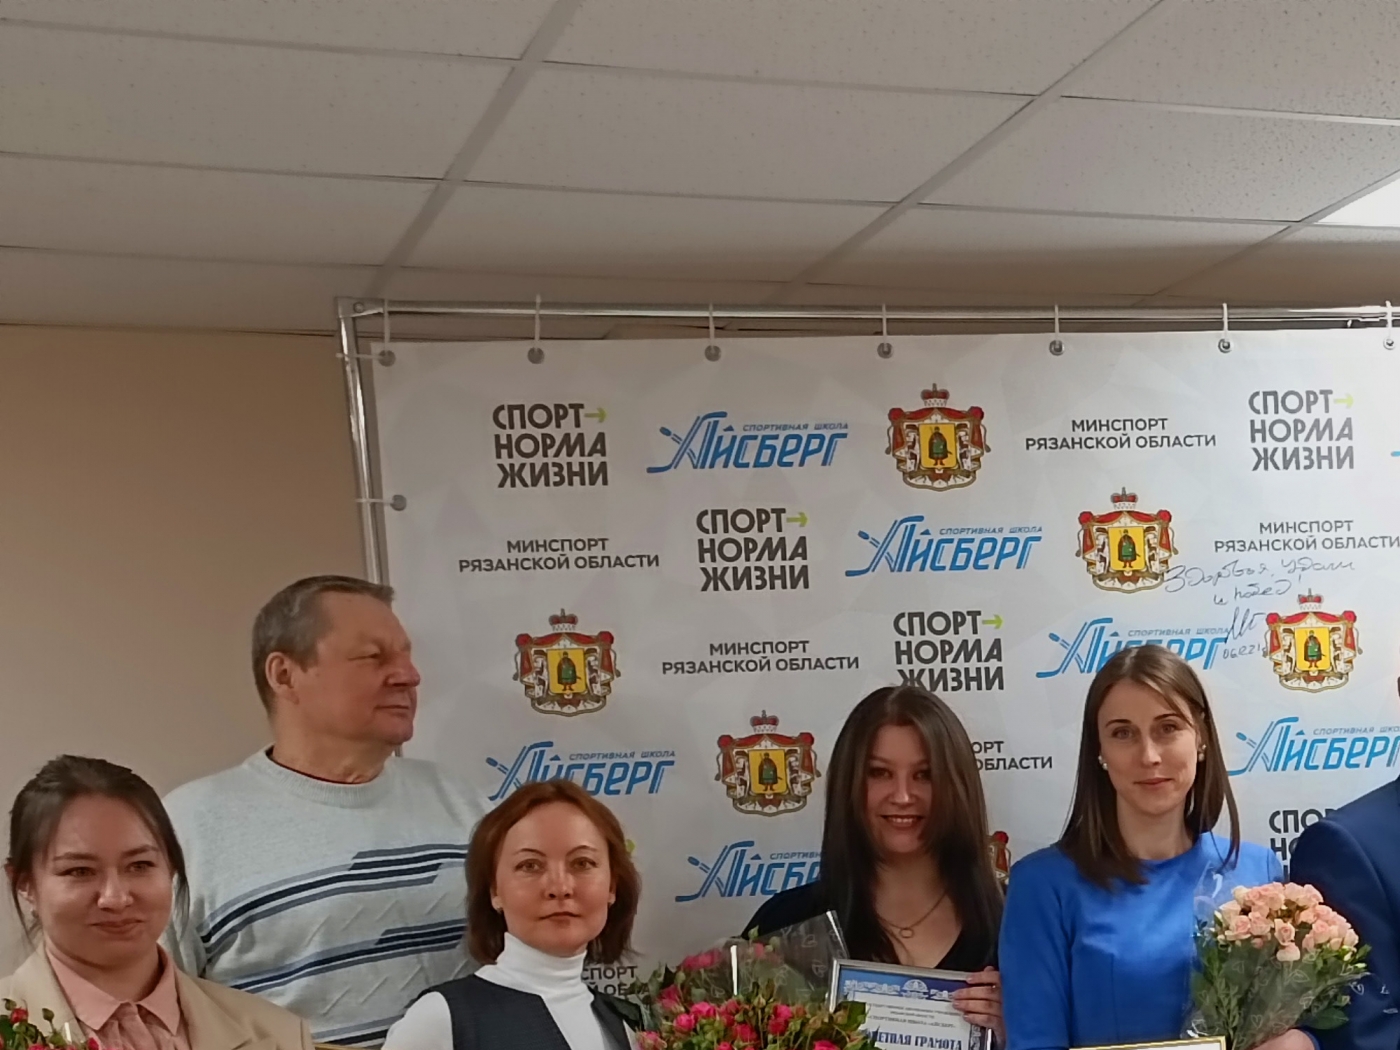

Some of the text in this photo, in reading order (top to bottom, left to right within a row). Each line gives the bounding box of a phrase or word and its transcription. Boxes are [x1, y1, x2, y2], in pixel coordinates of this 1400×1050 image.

[1248, 389, 1333, 415] СПОРТ
[492, 403, 584, 431] СПОРТ
[1071, 417, 1168, 433] МИНСПОРТ
[1250, 417, 1354, 443] НОРМА
[494, 432, 607, 459] НОРМА
[1025, 433, 1217, 452] РЯЗАНСКОЙ ОБЛАСТИ
[1251, 445, 1355, 472] ЖИЗНИ
[497, 461, 609, 488] ЖИЗНИ
[696, 508, 787, 534] СПОРТ
[1258, 519, 1354, 535] МИНСПОРТ
[507, 537, 609, 554] МИНСПОРТ
[697, 536, 809, 563] НОРМА
[1213, 534, 1400, 554] РЯЗАНСКОЙ ОБЛАСТИ
[458, 554, 660, 573] РЯЗАНСКОЙ ОБЛАСТИ
[700, 565, 810, 592] ЖИЗНИ
[893, 610, 982, 637] СПОРТ
[708, 639, 810, 657] МИНСПОРТ
[895, 638, 1003, 665] НОРМА
[661, 656, 860, 675] РЯЗАНСКОЙ ОБЛАСТИ
[897, 666, 1004, 692] ЖИЗНИ
[1268, 808, 1336, 834] СПО
[581, 965, 638, 981] СПОРТ
